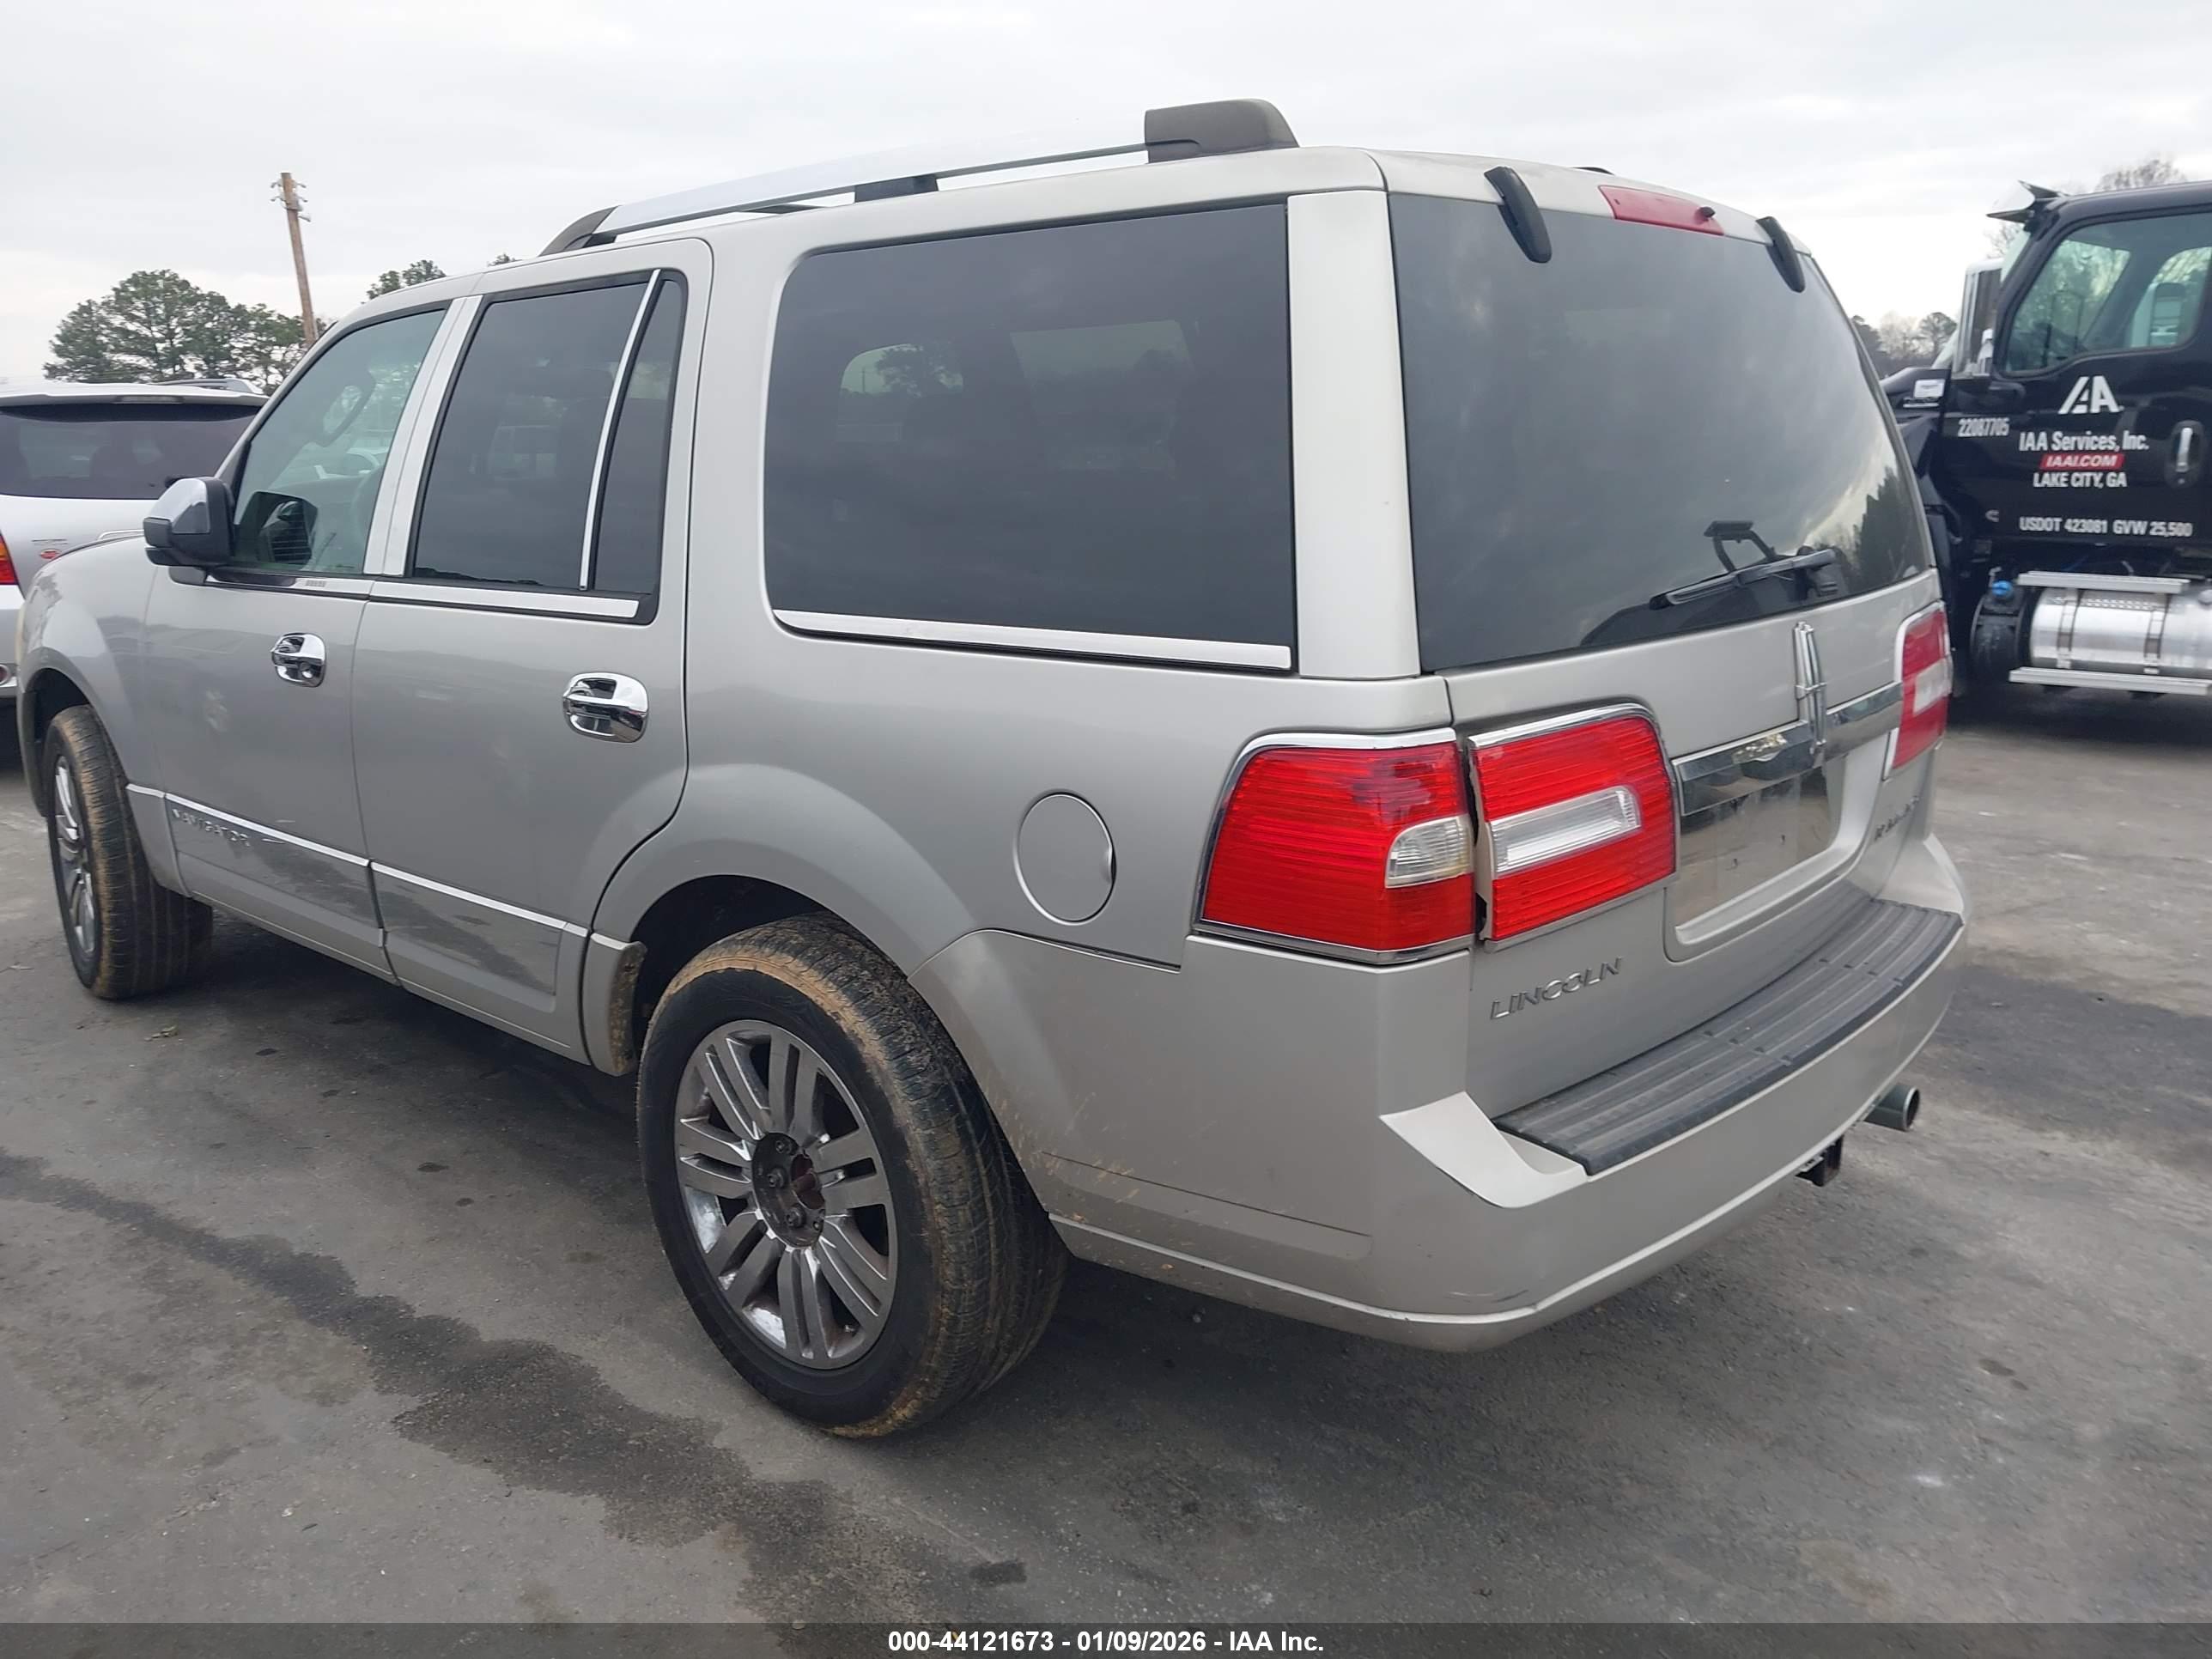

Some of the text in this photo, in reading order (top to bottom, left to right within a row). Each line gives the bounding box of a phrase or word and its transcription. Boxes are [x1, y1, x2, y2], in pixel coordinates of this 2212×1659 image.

[2020, 431, 2149, 452] IAA Services, Inc.
[2033, 472, 2127, 489] LAKE CITY, GA
[2019, 517, 2194, 538] USDOT 423081 GVW 25,500
[1490, 956, 1623, 1020] LINCOLN
